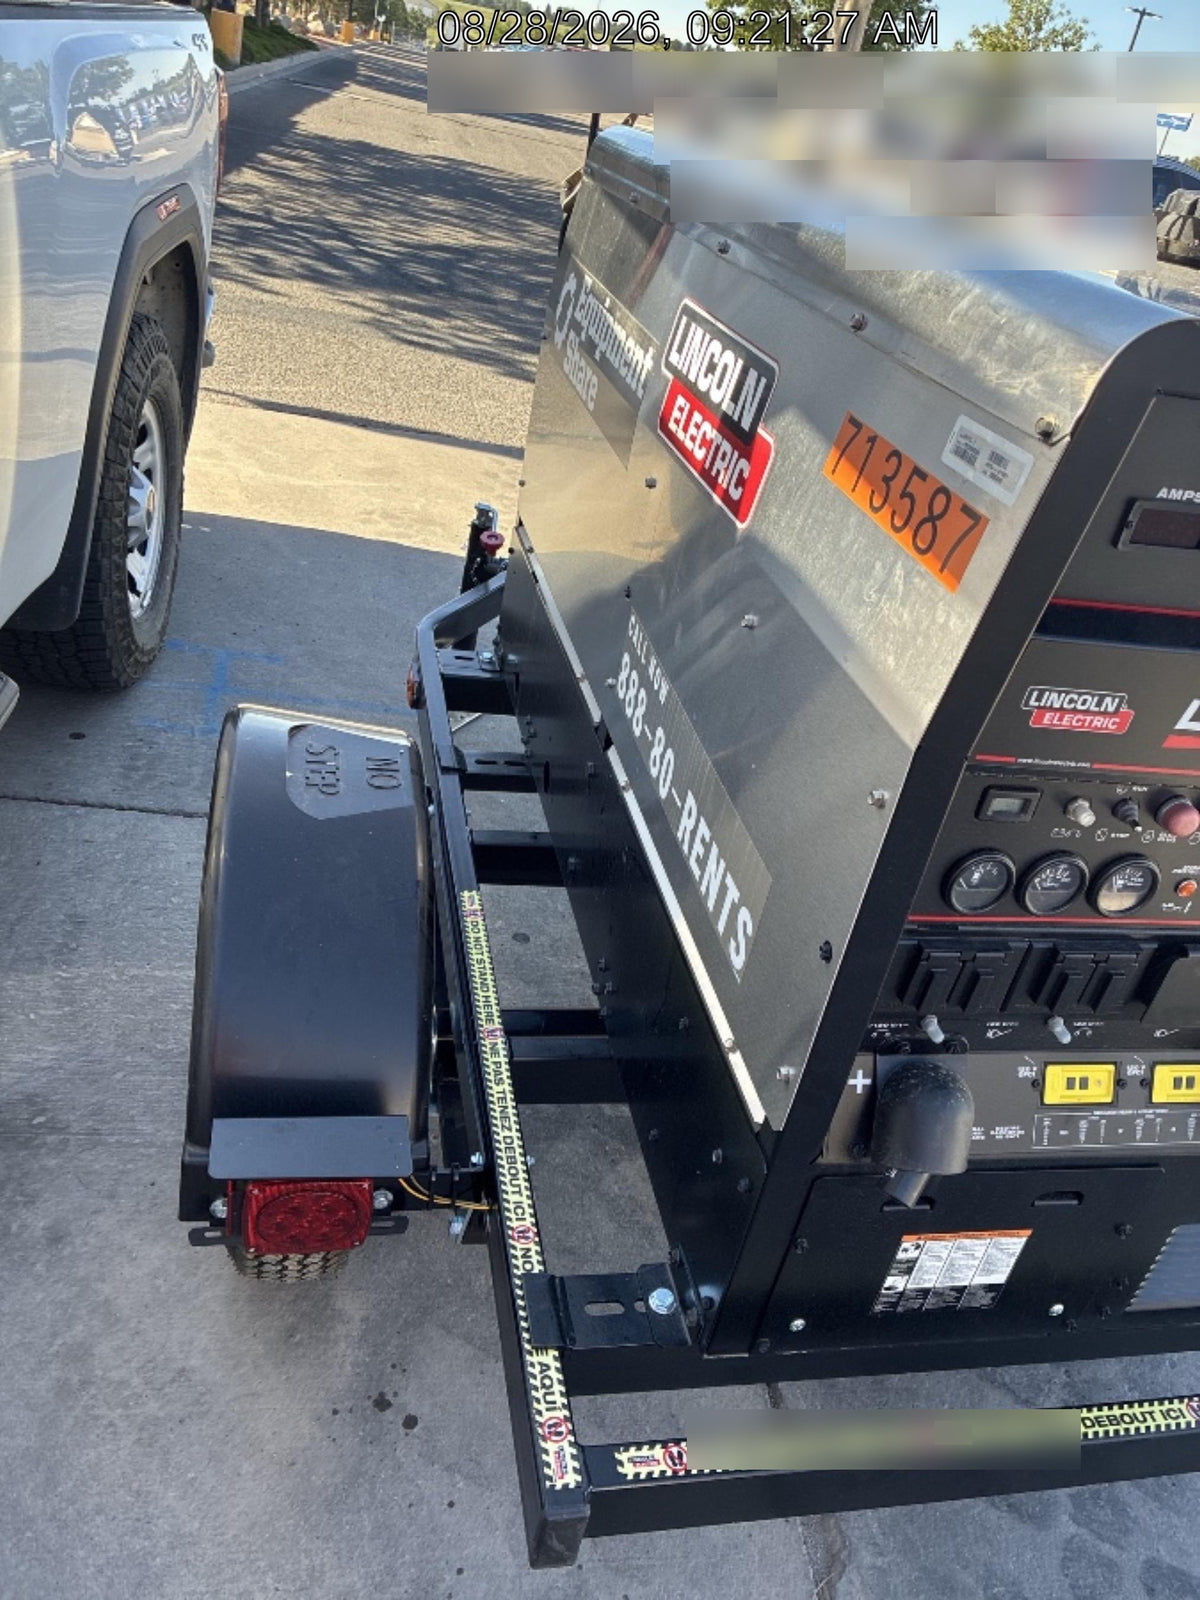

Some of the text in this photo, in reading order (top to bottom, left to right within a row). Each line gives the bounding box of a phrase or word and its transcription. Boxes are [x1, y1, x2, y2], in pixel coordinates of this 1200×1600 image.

[574, 274, 654, 400] Equipment
[563, 329, 598, 412] Share
[668, 315, 767, 432] LINCOLN
[667, 394, 750, 501] ELECTRIC
[832, 416, 982, 574] 713587
[628, 614, 669, 705] CALL NOW
[1029, 690, 1120, 713] LINCOLN
[1042, 711, 1121, 730] ELECTRIC
[305, 743, 341, 796] STEP
[366, 756, 402, 790] NO
[617, 652, 753, 971] 888-80-RENTS
[470, 921, 480, 934] DO
[473, 936, 483, 956] NOT
[475, 958, 490, 993] STAND
[481, 995, 495, 1026] HERE
[489, 1042, 527, 1222] NE PAS TENEZ DEBOUT ICI
[519, 1247, 535, 1272] NO
[1081, 1407, 1187, 1430] DEBOUT ICI
